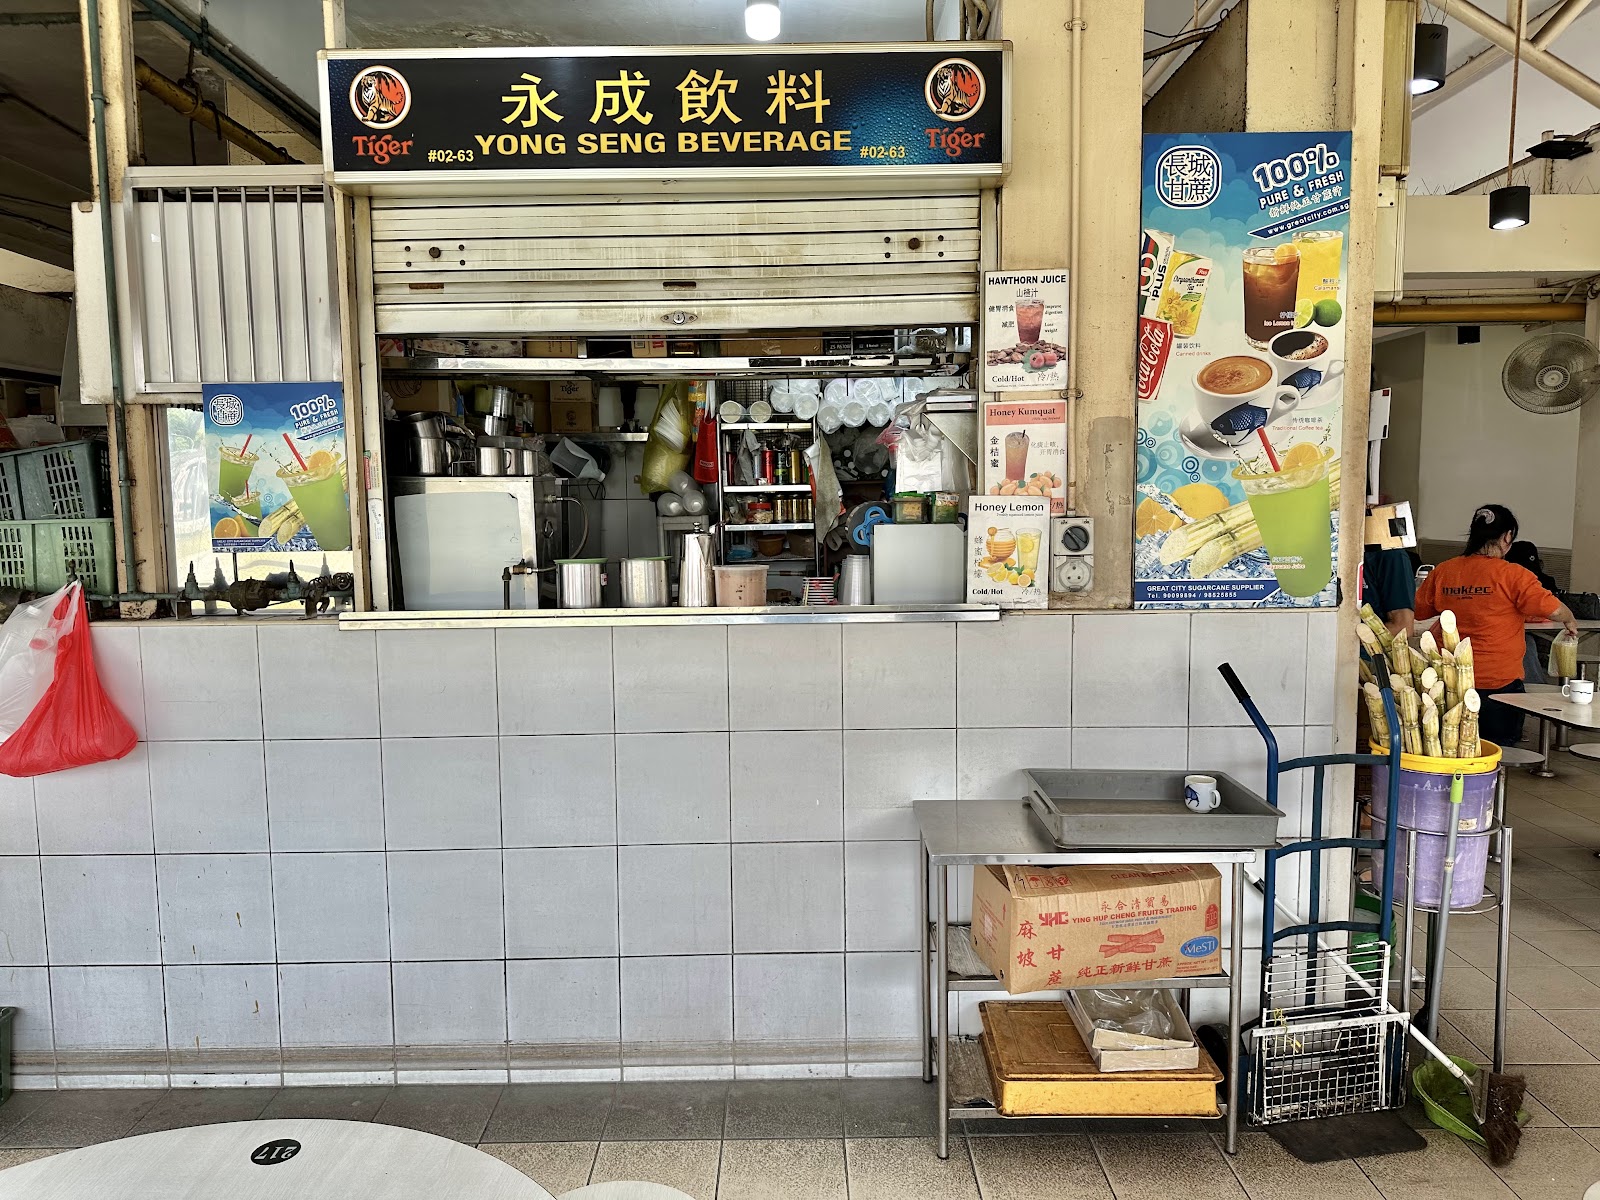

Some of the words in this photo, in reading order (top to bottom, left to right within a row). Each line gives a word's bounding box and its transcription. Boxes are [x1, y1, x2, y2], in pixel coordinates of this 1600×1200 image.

[501, 69, 831, 128] 永成飲料
[352, 134, 413, 165] Tiger
[474, 132, 567, 155] YONG
[577, 132, 666, 154] SENG
[677, 129, 852, 153] BEVERAGE
[859, 146, 906, 159] #02-63
[924, 127, 986, 156] Tiger
[427, 149, 474, 163] #02-63
[1166, 153, 1211, 177] 長城
[1253, 143, 1340, 193] 100%
[1166, 178, 1211, 201] 甘蔗
[1259, 190, 1290, 209] PURE
[1293, 185, 1306, 197] &
[1308, 171, 1345, 191] FRESH
[1267, 202, 1350, 236] www.greatcity.com.sg
[988, 276, 1038, 285] HAWTHORN
[1040, 275, 1066, 284] JUICE
[1152, 264, 1167, 298] PLUS
[560, 384, 579, 394] Tiger
[992, 375, 1025, 383] Cold/Hot
[290, 394, 336, 420] 100%
[990, 408, 1016, 417] Honey
[1018, 407, 1056, 417] Kumquat
[295, 420, 309, 430] PURE
[319, 409, 338, 421] FRESH
[974, 503, 1007, 513] Honey
[1009, 503, 1044, 512] Lemon
[1442, 585, 1493, 594] maktec
[1039, 911, 1068, 926] YHC
[1110, 911, 1136, 920] CHENG
[1137, 909, 1164, 918] FRUITS
[1166, 904, 1198, 914] TRADING
[1016, 920, 1037, 967] 麻坡
[1184, 940, 1215, 954] MeSTI
[1044, 944, 1064, 987] 甘蔗
[254, 1146, 297, 1160] 217
